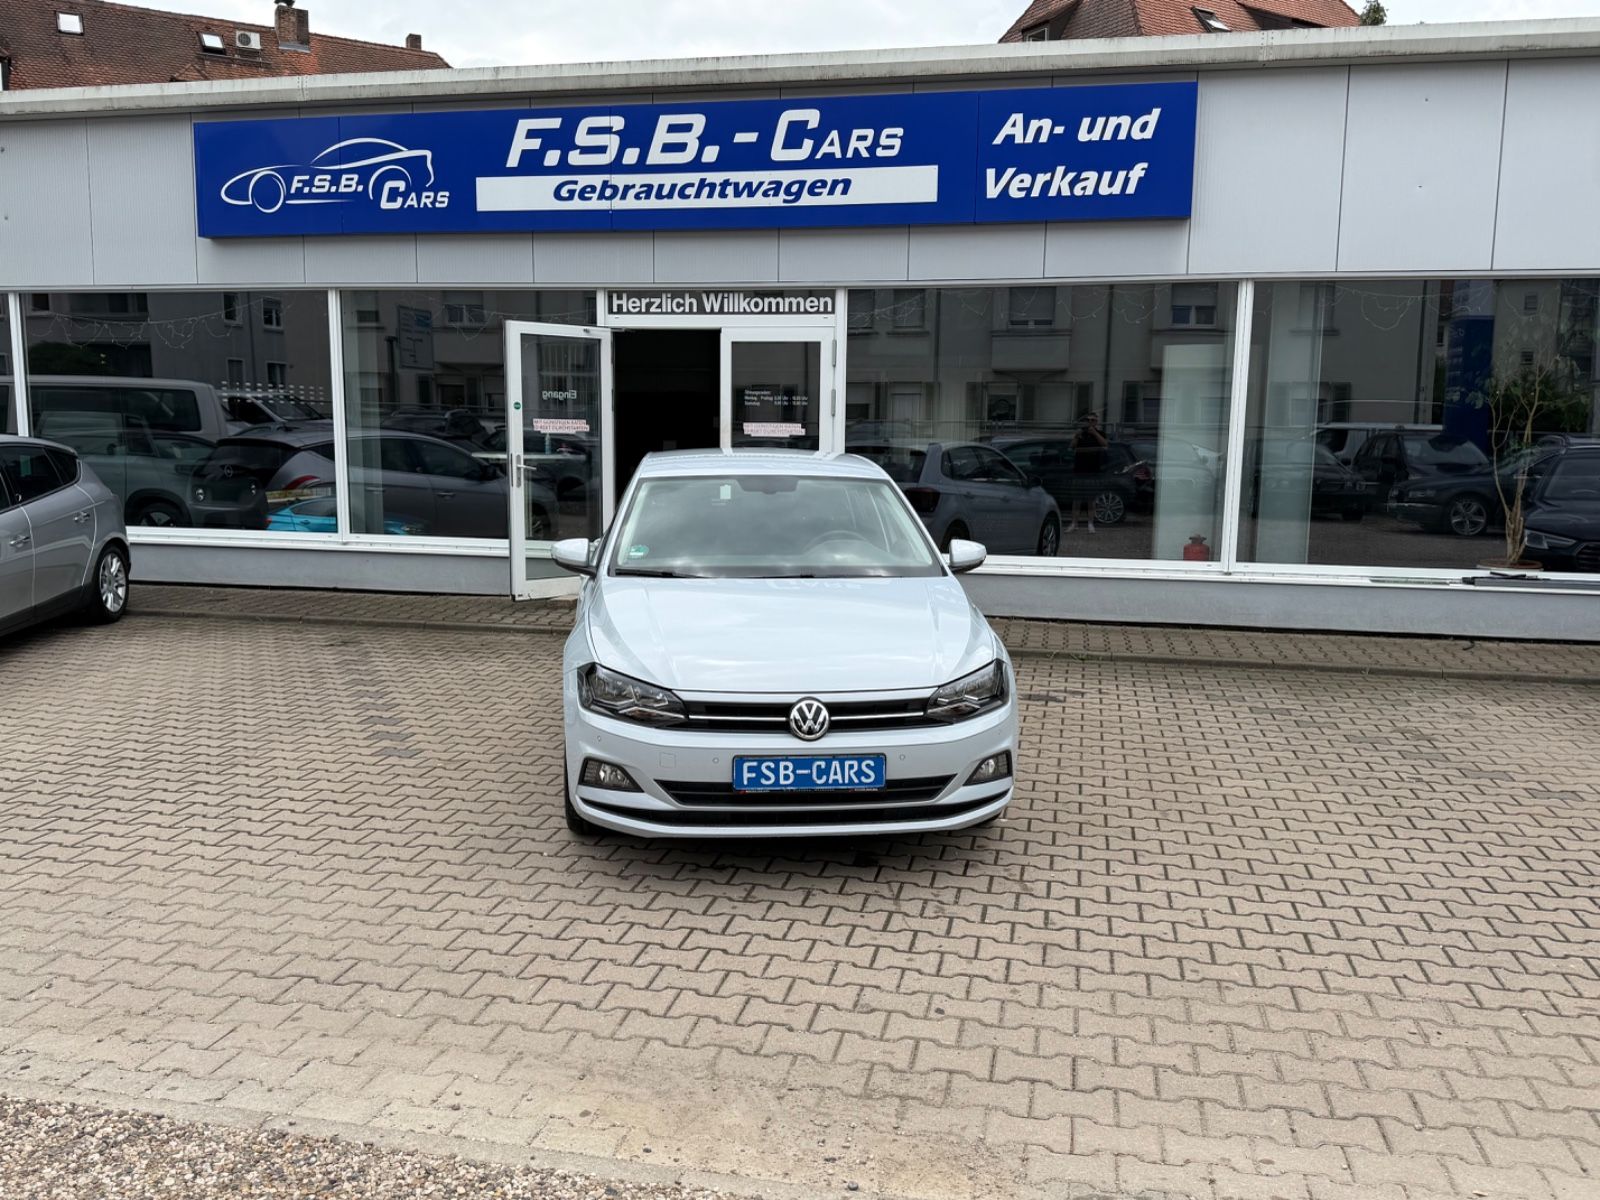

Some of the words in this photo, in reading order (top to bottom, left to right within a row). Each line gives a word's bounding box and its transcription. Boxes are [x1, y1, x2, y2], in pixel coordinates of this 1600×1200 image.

[992, 112, 1065, 145] An-
[1077, 107, 1162, 142] und
[290, 174, 364, 194] F.S.B.
[552, 176, 852, 204] Gebrauchtwagen
[986, 162, 1149, 199] Verkauf
[612, 292, 698, 313] Herzlich
[702, 292, 832, 313] Willkommen
[742, 760, 876, 786] FSB-CARS
